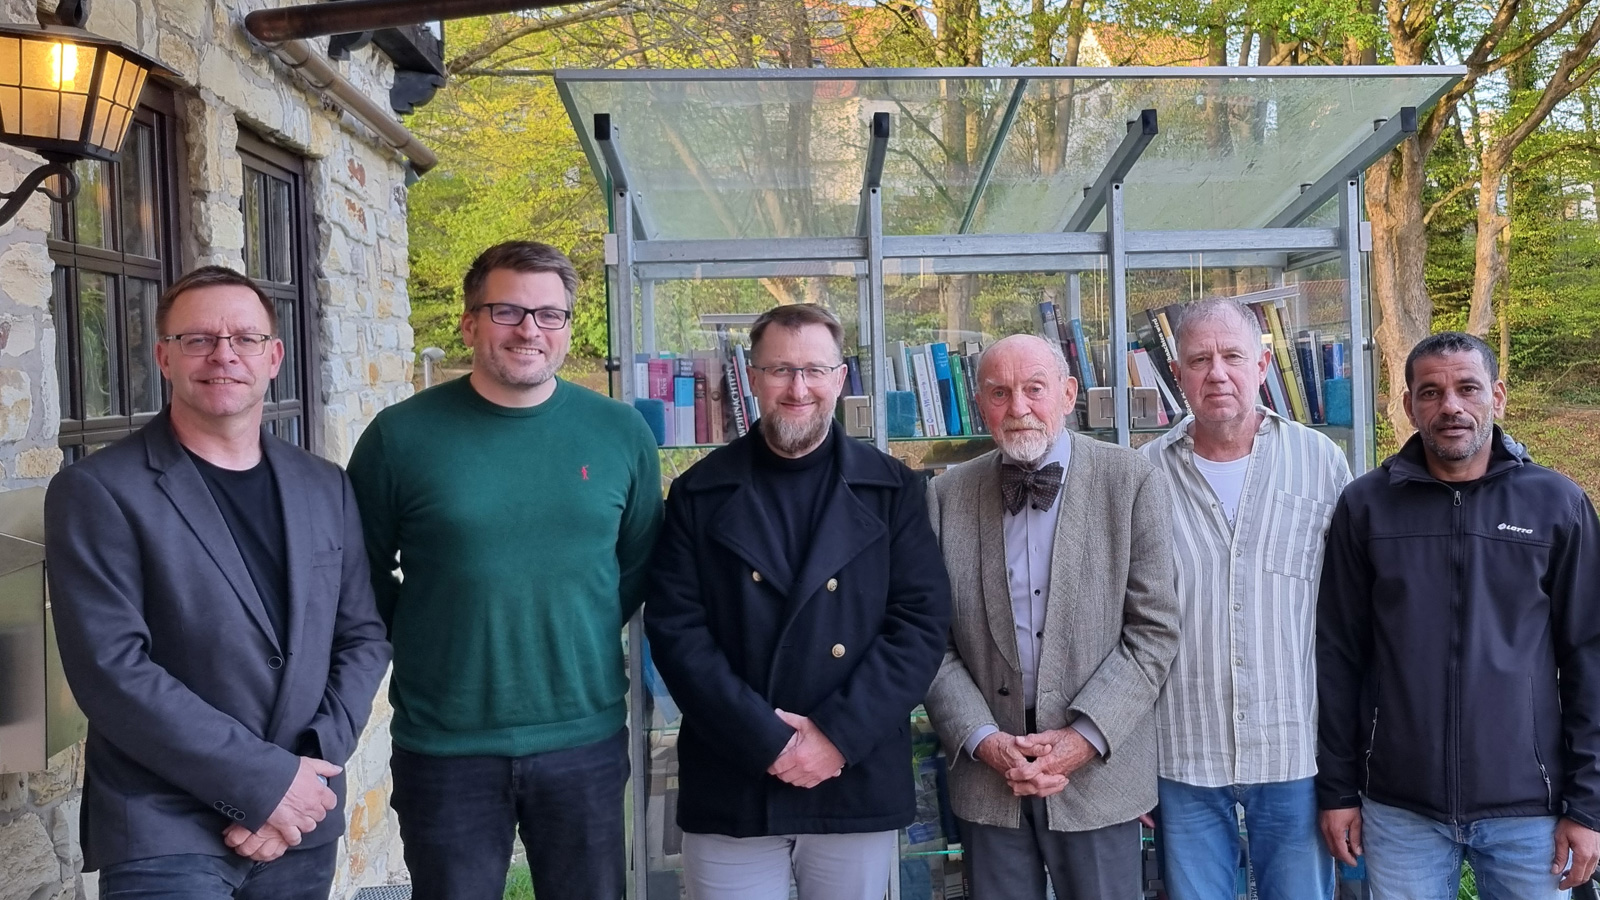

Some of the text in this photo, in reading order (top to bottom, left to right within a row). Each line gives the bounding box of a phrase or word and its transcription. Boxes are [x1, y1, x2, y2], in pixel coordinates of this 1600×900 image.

[1152, 318, 1161, 333] wird
[727, 369, 747, 438] WEIHNACHTEN
[1506, 524, 1534, 534] LOTTO
